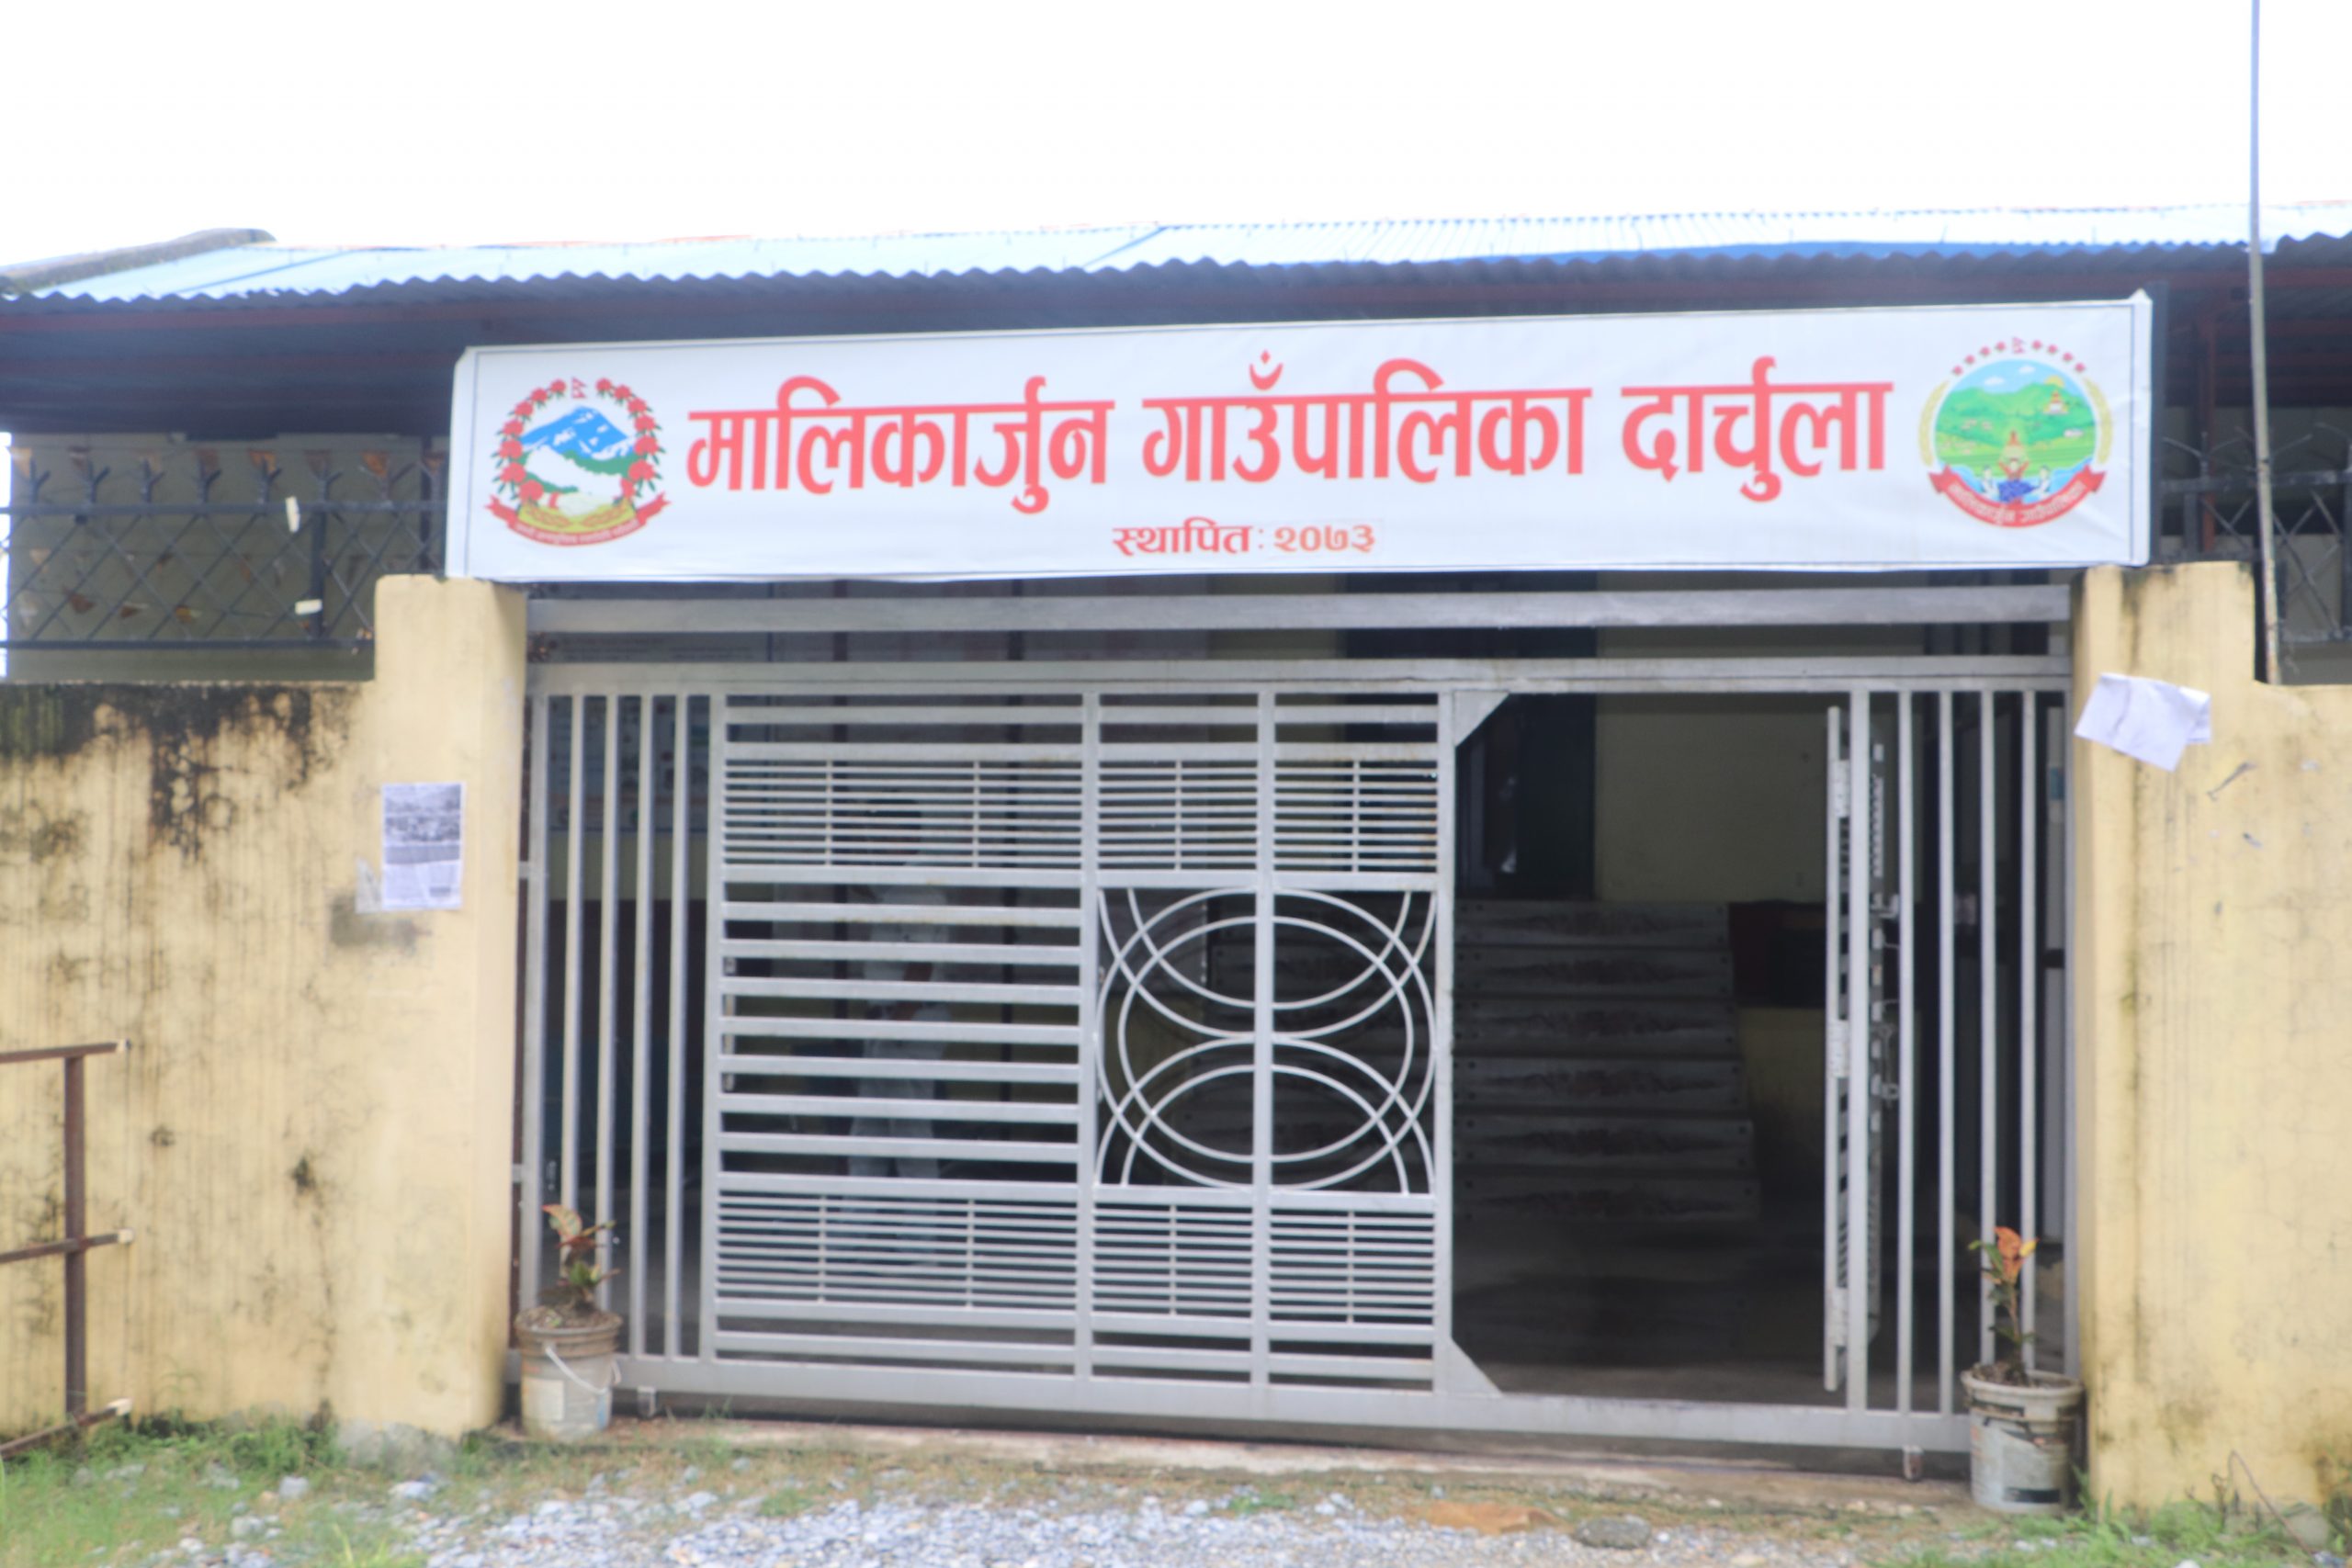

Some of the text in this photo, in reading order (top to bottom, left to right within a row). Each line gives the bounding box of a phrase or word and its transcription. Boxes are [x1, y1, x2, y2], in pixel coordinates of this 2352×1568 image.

[685, 349, 1894, 514] मालिकार्जुन गाउँपालिका दार्चुला
[1273, 524, 1375, 553] २०७३
